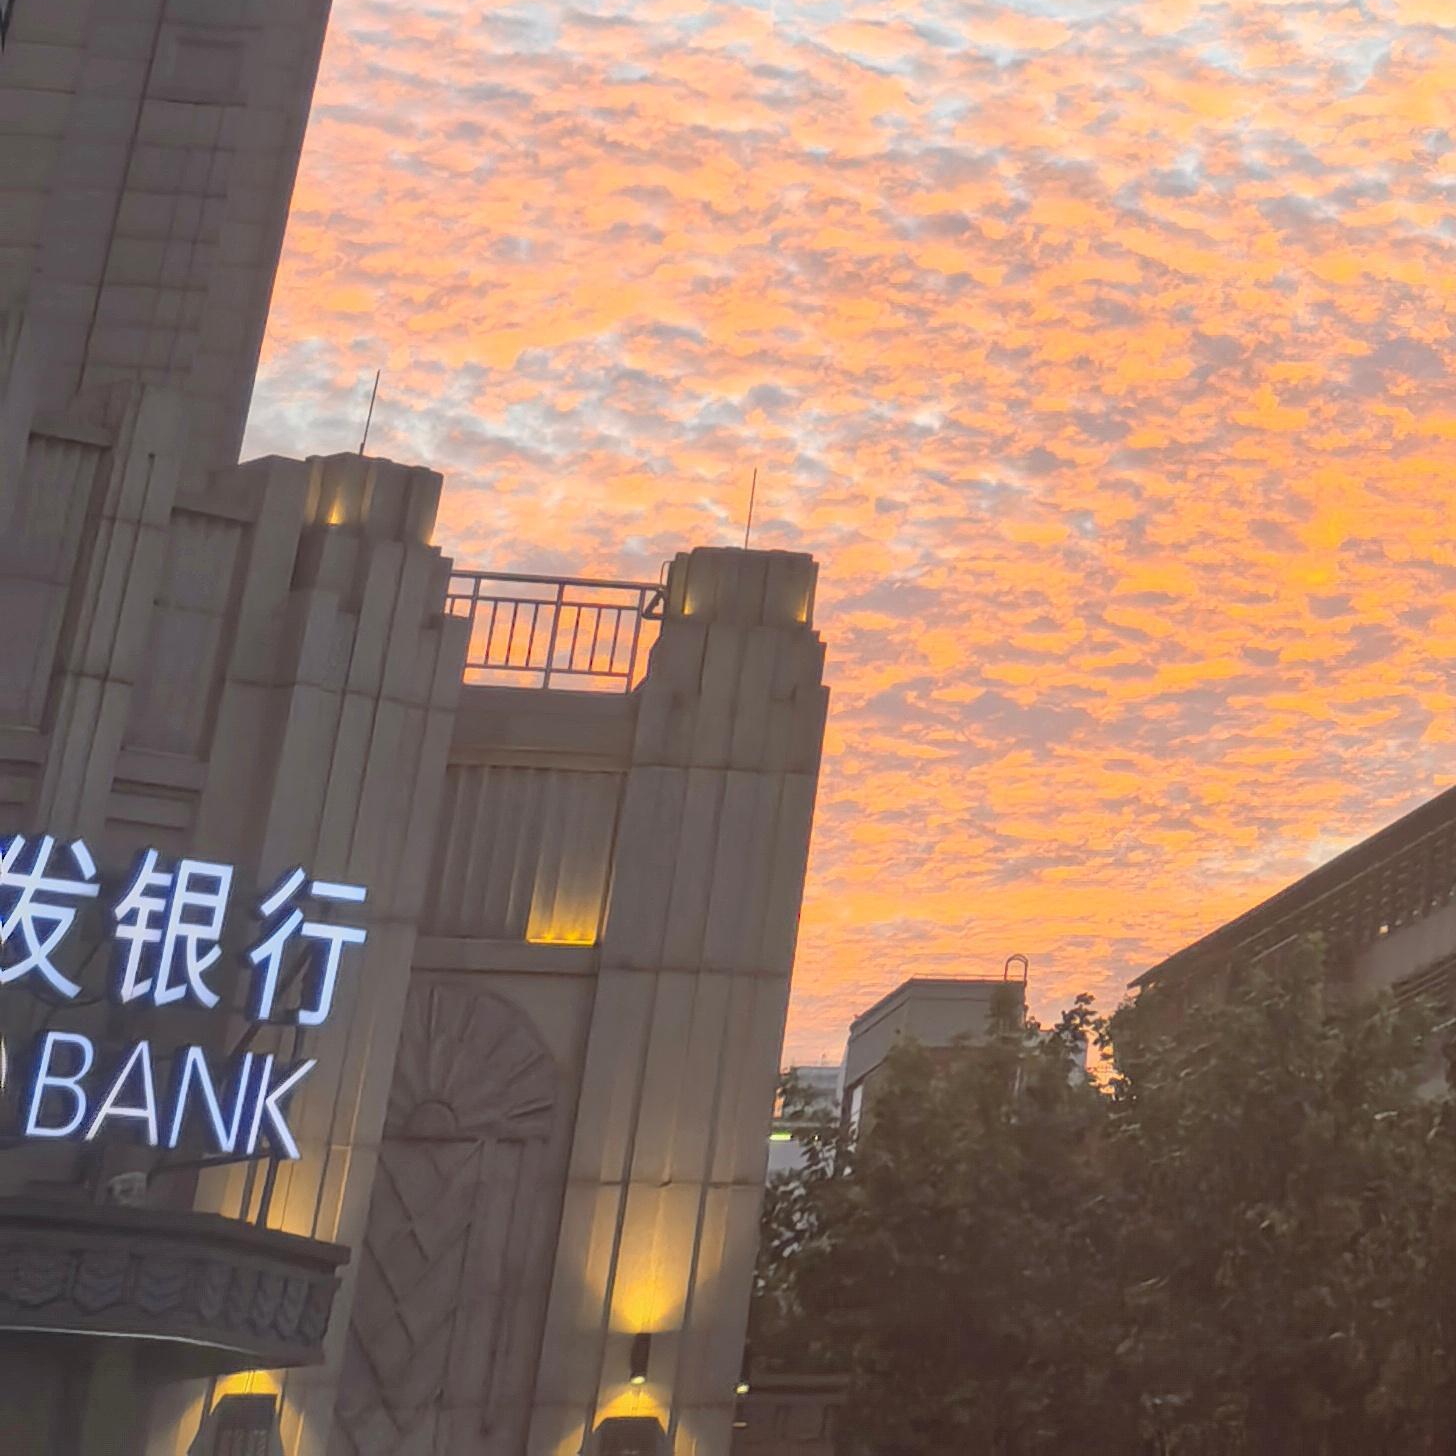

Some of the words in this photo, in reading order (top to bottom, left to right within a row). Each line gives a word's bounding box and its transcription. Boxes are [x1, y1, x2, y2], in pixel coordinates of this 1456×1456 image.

[0, 834, 367, 1026] 发银行
[25, 1031, 317, 1159] BANK
